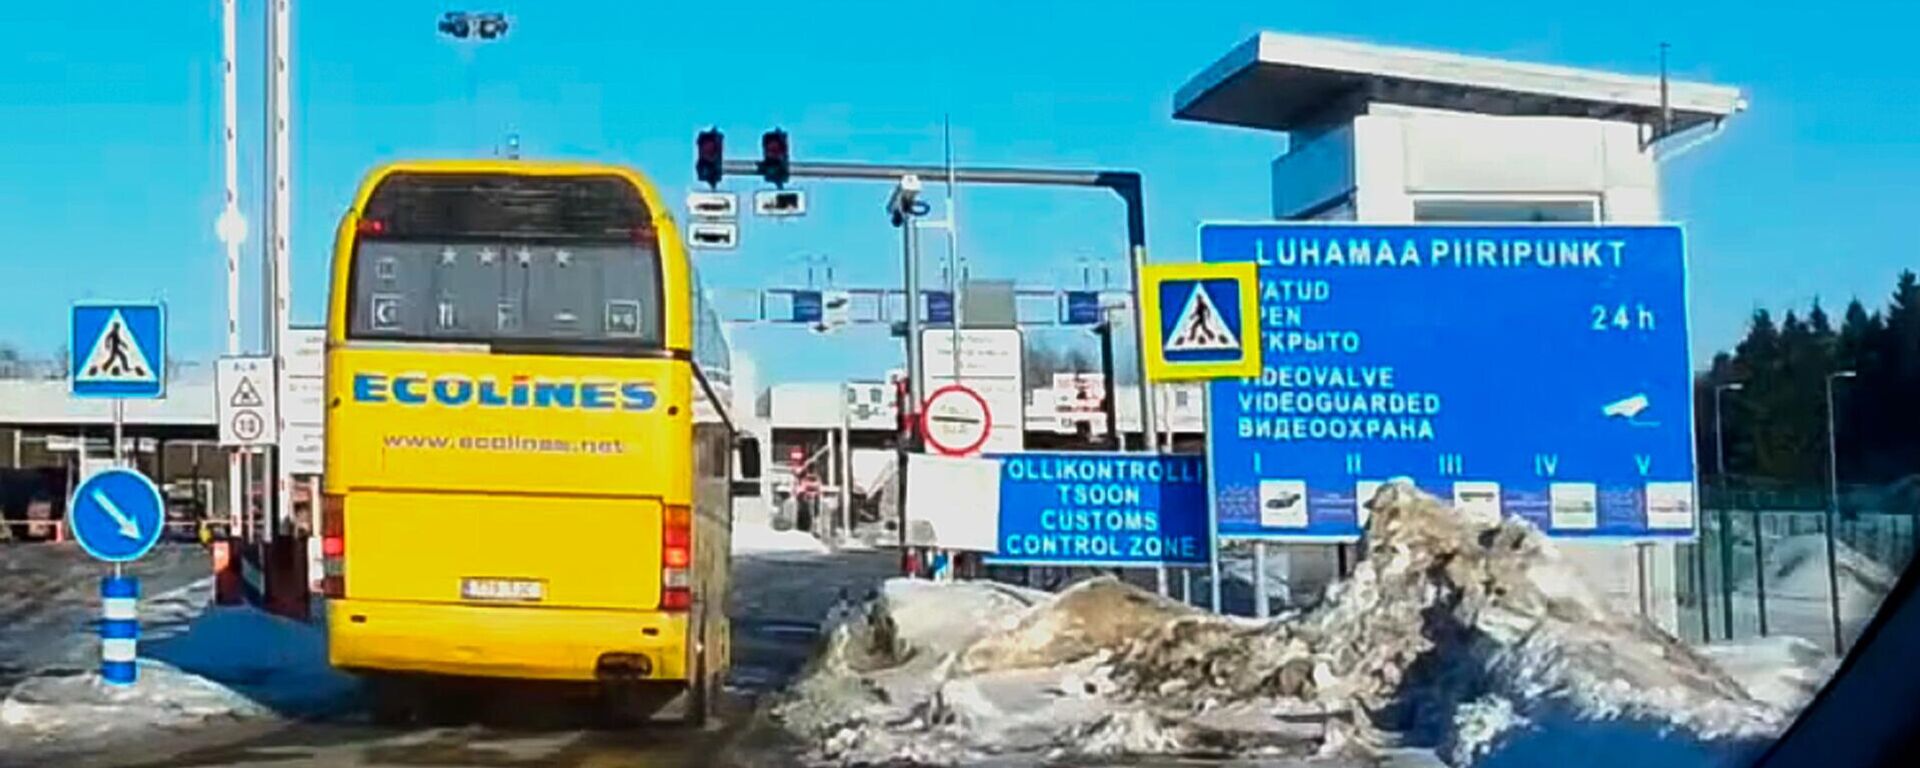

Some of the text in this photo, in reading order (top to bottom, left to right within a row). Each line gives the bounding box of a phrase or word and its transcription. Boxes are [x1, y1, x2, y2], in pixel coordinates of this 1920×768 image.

[1255, 238, 1626, 268] LUHAMAA PIIRIPUNKT
[1591, 304, 1655, 331] 24 h
[1237, 391, 1441, 415] VIDEOGUARDED
[1237, 416, 1435, 440] ВИДЕООХРАНА
[383, 433, 624, 454] www.ecolines.net
[1346, 453, 1361, 475] II
[1439, 454, 1463, 475] III
[1535, 454, 1558, 476] IV
[1635, 454, 1650, 476] V
[1057, 483, 1140, 505] TSOON
[1040, 508, 1158, 531] CUSTOMS
[1006, 534, 1197, 557] CONTROL ZONE
